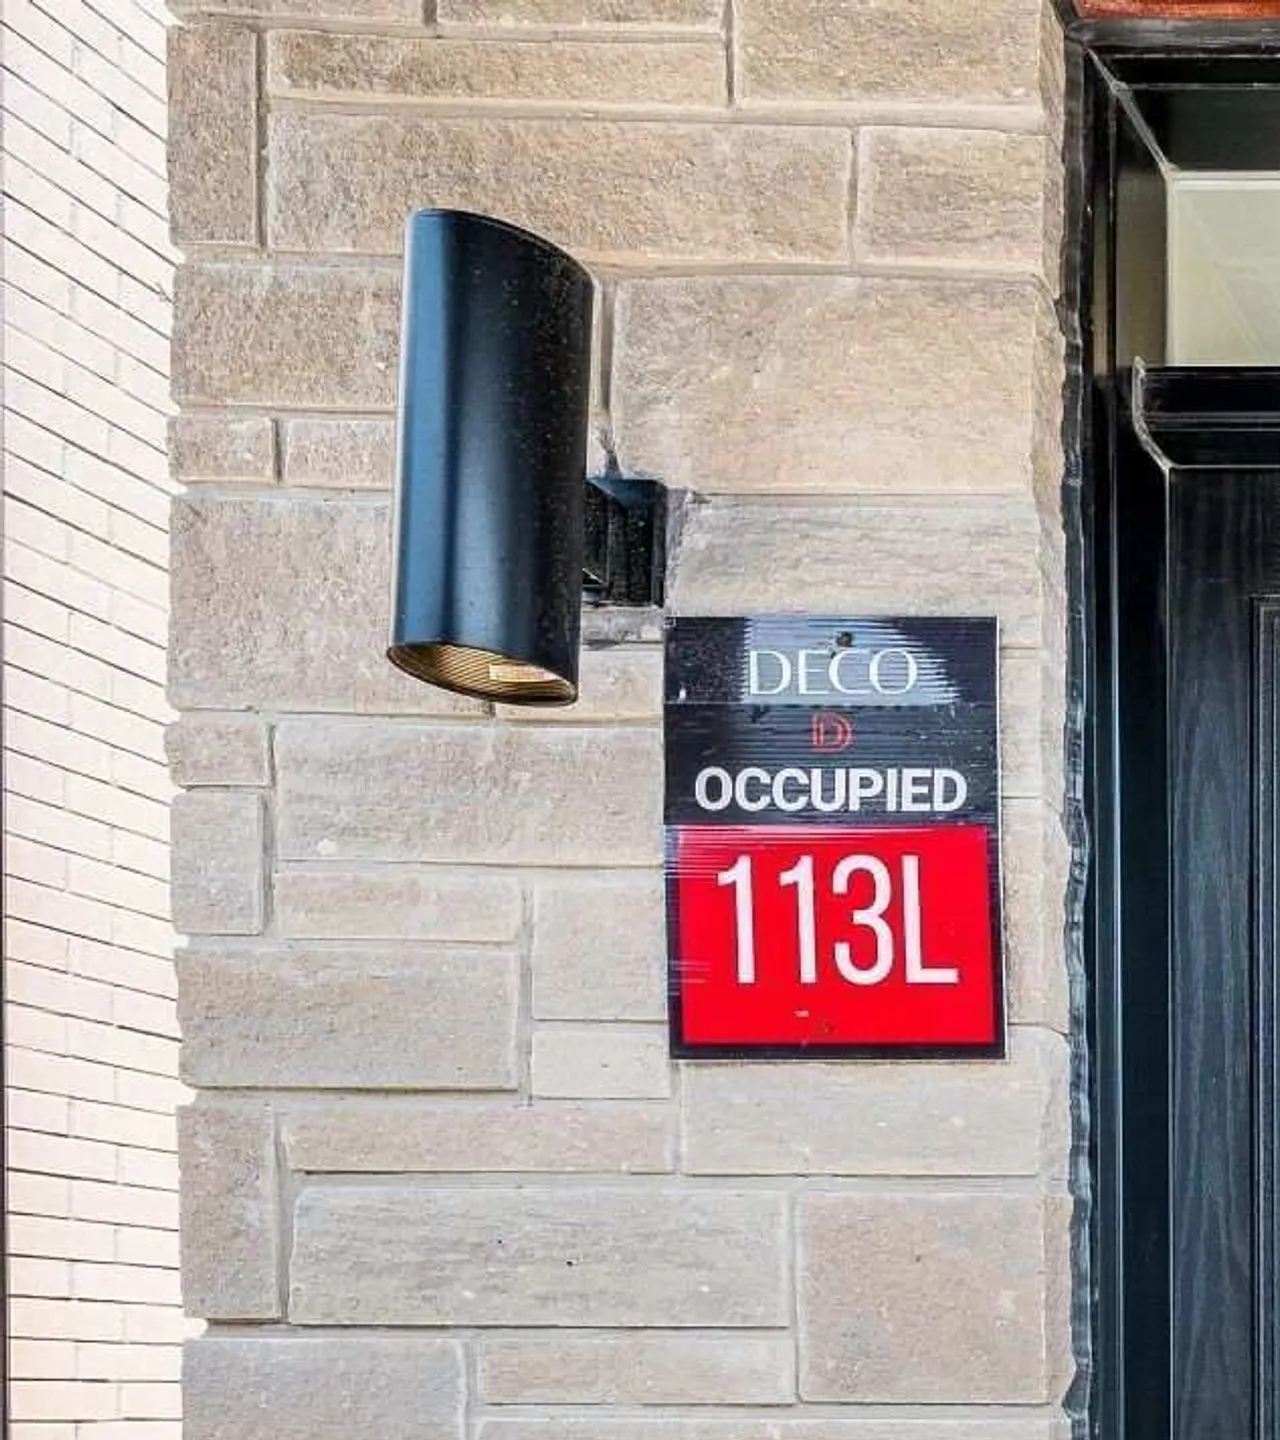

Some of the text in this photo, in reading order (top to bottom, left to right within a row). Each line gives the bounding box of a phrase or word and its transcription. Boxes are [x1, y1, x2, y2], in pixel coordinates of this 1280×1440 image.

[749, 648, 918, 696] DECO
[694, 766, 968, 813] OCCUPIED
[716, 853, 960, 985] 113L
